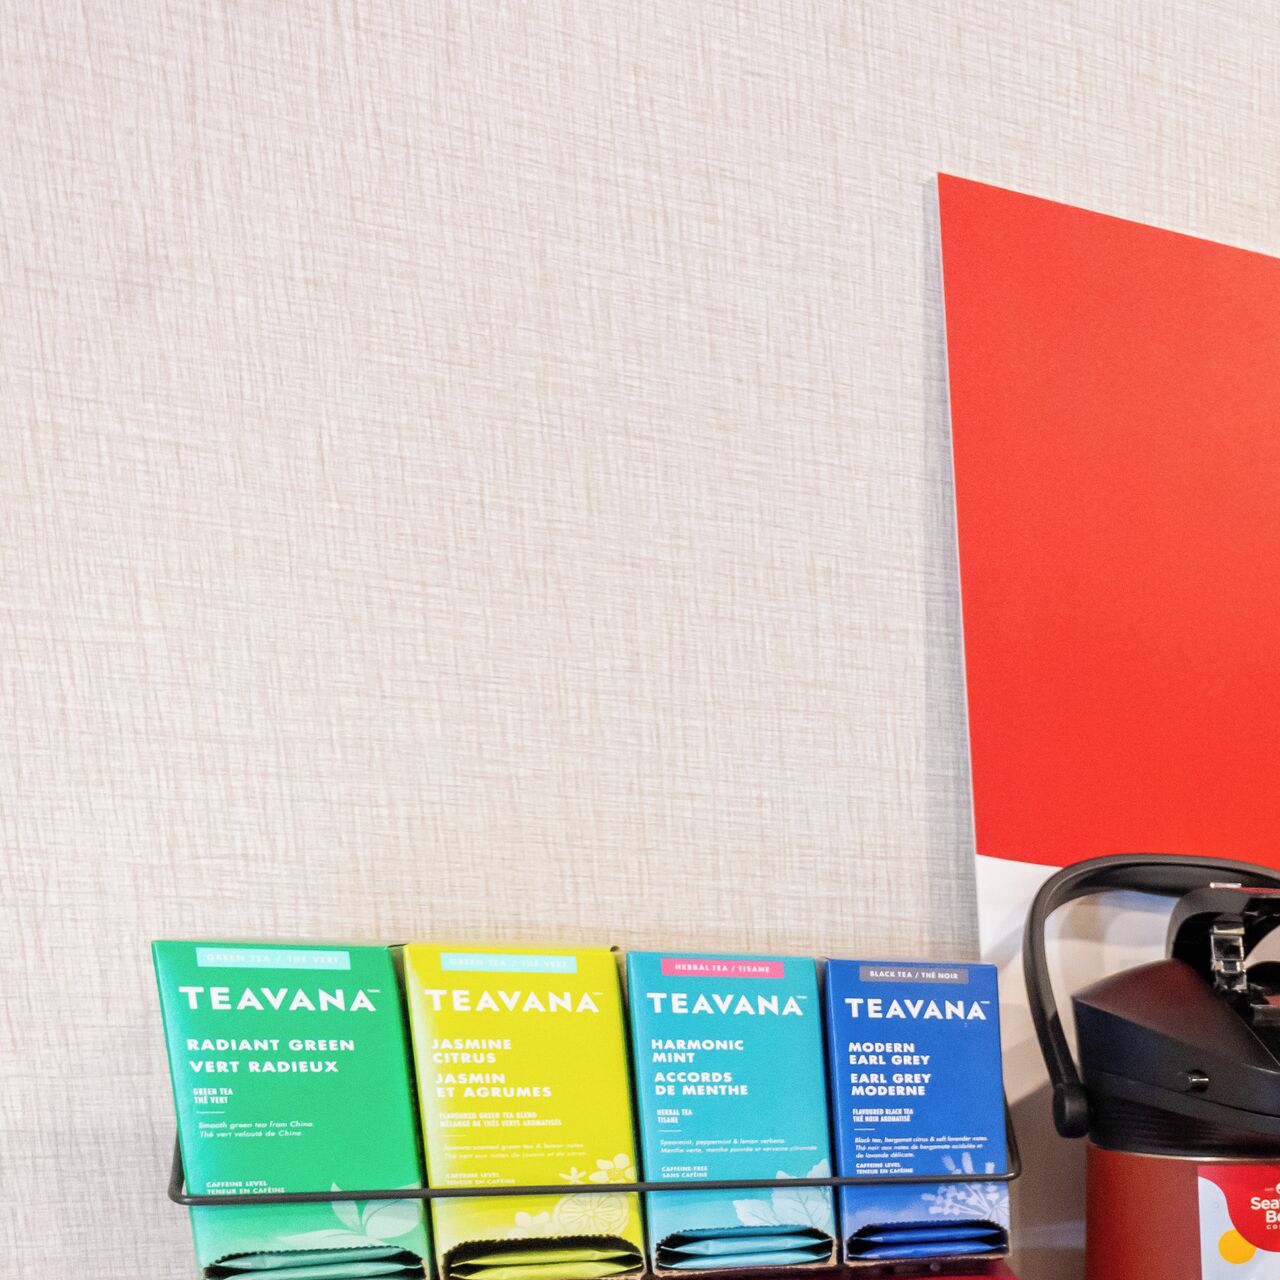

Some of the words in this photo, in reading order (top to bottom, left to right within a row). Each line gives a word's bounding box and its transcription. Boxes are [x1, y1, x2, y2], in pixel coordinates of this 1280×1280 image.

[739, 965, 769, 973] TISANE
[187, 1039, 279, 1050] RADIANT
[289, 1040, 355, 1050] GREEN
[432, 1039, 512, 1049] JASMINE
[651, 1040, 744, 1050] HARMONIC
[849, 1043, 915, 1052] MODERN
[433, 1052, 496, 1063] CITRUS
[652, 1053, 695, 1063] MINT
[849, 1055, 886, 1065] EARL
[891, 1055, 930, 1065] GREY
[189, 1061, 241, 1073] VERT
[249, 1060, 339, 1073] RADIEUX
[435, 1073, 505, 1083] JASMIN
[655, 1072, 732, 1082] ACCORDS
[850, 1074, 887, 1083] EARL
[892, 1074, 931, 1083] GREY
[437, 1088, 455, 1098] ET
[464, 1087, 552, 1097] AGRUMES
[655, 1085, 675, 1095] DE
[683, 1085, 748, 1095] MENTHE
[852, 1086, 925, 1095] MODERNE
